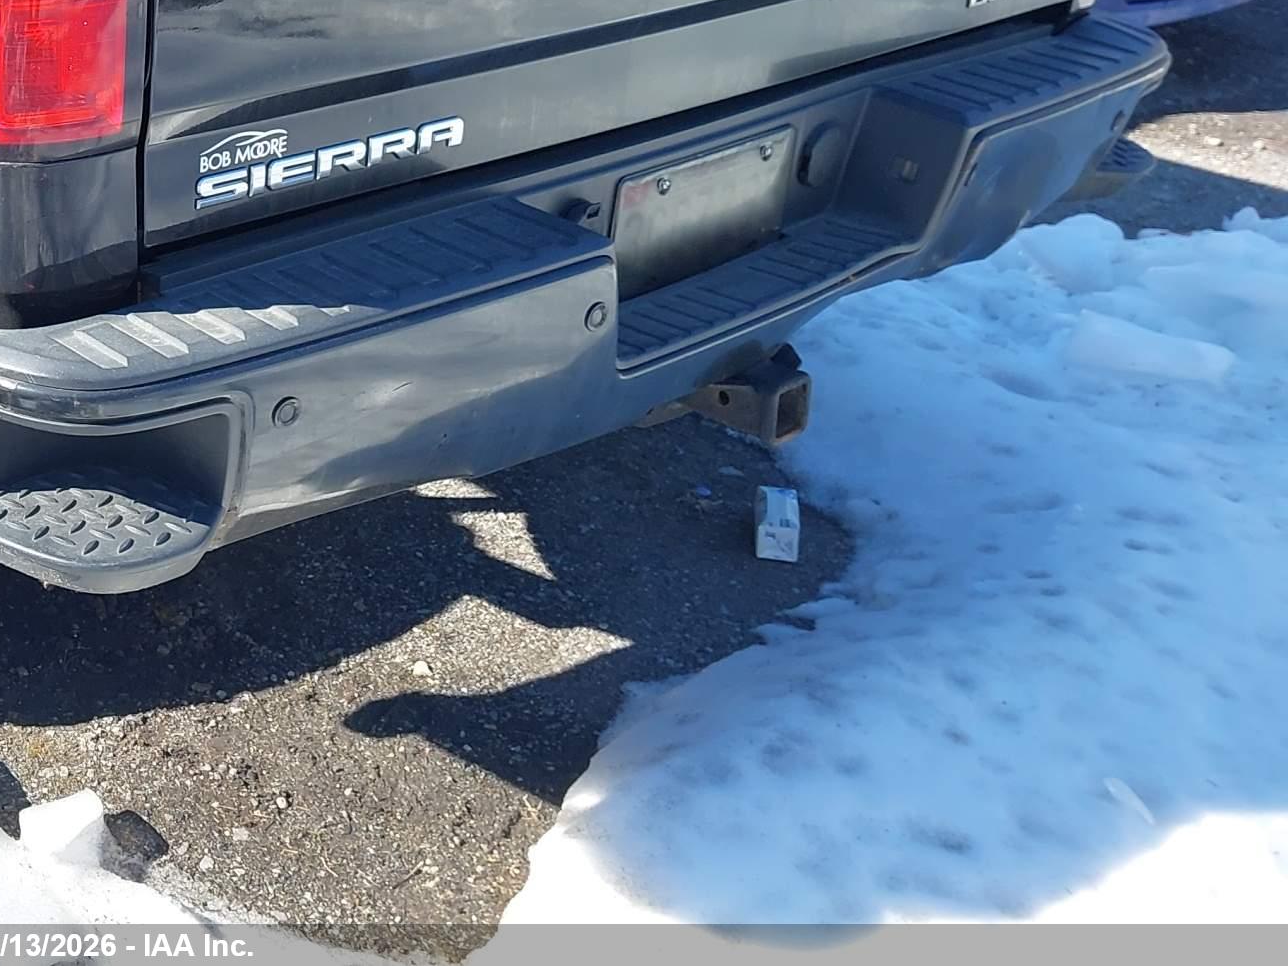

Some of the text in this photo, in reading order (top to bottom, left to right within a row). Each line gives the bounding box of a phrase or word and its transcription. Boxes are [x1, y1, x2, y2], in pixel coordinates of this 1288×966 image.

[195, 115, 465, 210] SIERRA
[199, 137, 288, 174] BOB MOORE
